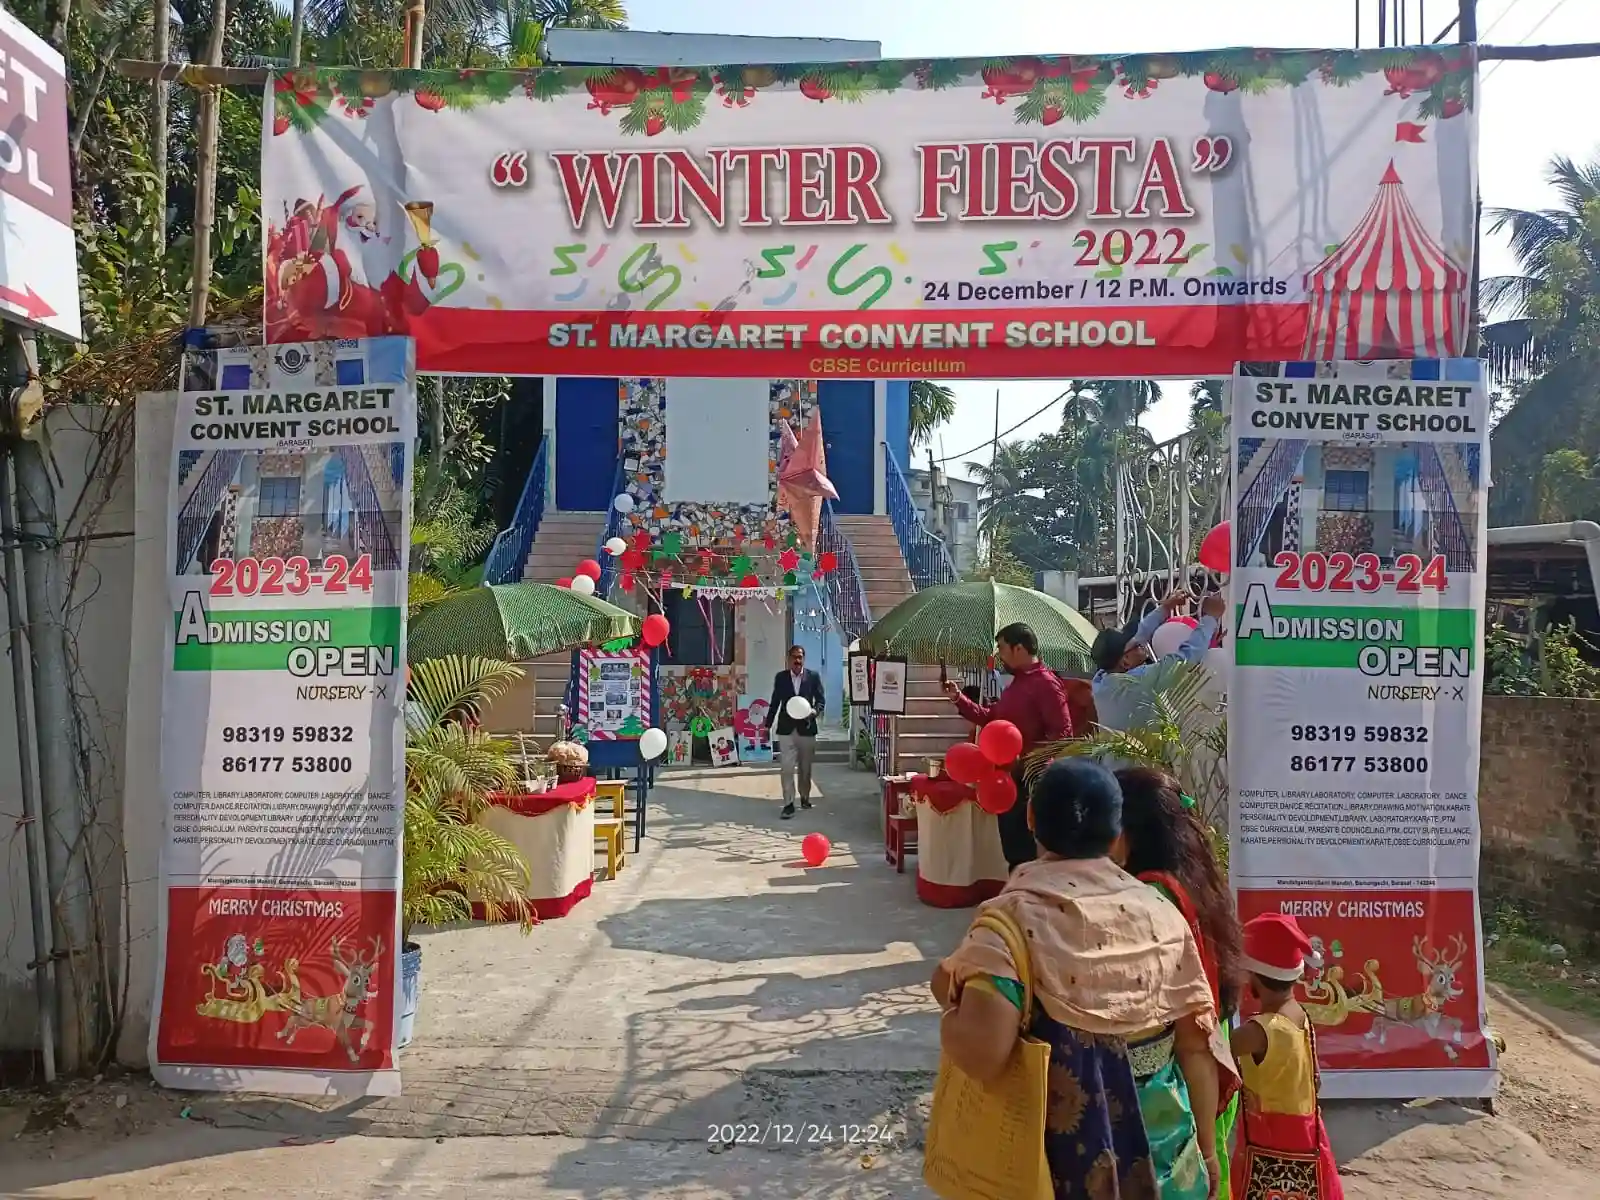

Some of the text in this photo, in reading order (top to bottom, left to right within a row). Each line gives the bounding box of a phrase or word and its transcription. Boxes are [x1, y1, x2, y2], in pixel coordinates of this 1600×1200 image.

[551, 142, 891, 229] WINTER
[1074, 227, 1190, 267] 2022
[924, 277, 1288, 301] 24 December / 12 P.M. Onwards
[548, 321, 1156, 350] ST. MARGARET CONVENT SCHOOL
[809, 357, 966, 374] CBSE Curriculum
[195, 388, 395, 417] ST. MARGARET
[1256, 382, 1472, 408] ST. MARGARET
[190, 416, 400, 441] CONVENT SCHOOL
[1251, 410, 1476, 433] CONVENT SCHOOL
[276, 439, 315, 448] (BARASAT)
[1342, 432, 1383, 441] (BARASAT)
[209, 553, 375, 597] 2023-24
[1273, 551, 1449, 595] 2023-24
[287, 646, 395, 678] OPEN
[1357, 644, 1471, 678] OPEN
[296, 685, 367, 701] NURSERY
[1367, 685, 1441, 702] NURSERY
[222, 726, 354, 743] 98319 59832
[1291, 725, 1429, 743] 98319 59832
[222, 756, 352, 773] 86177 53800
[1290, 755, 1428, 773] 86177 53800
[208, 899, 345, 918] MERRY CHRISTMAS
[1279, 900, 1425, 918] MERRY CHRISTMAS
